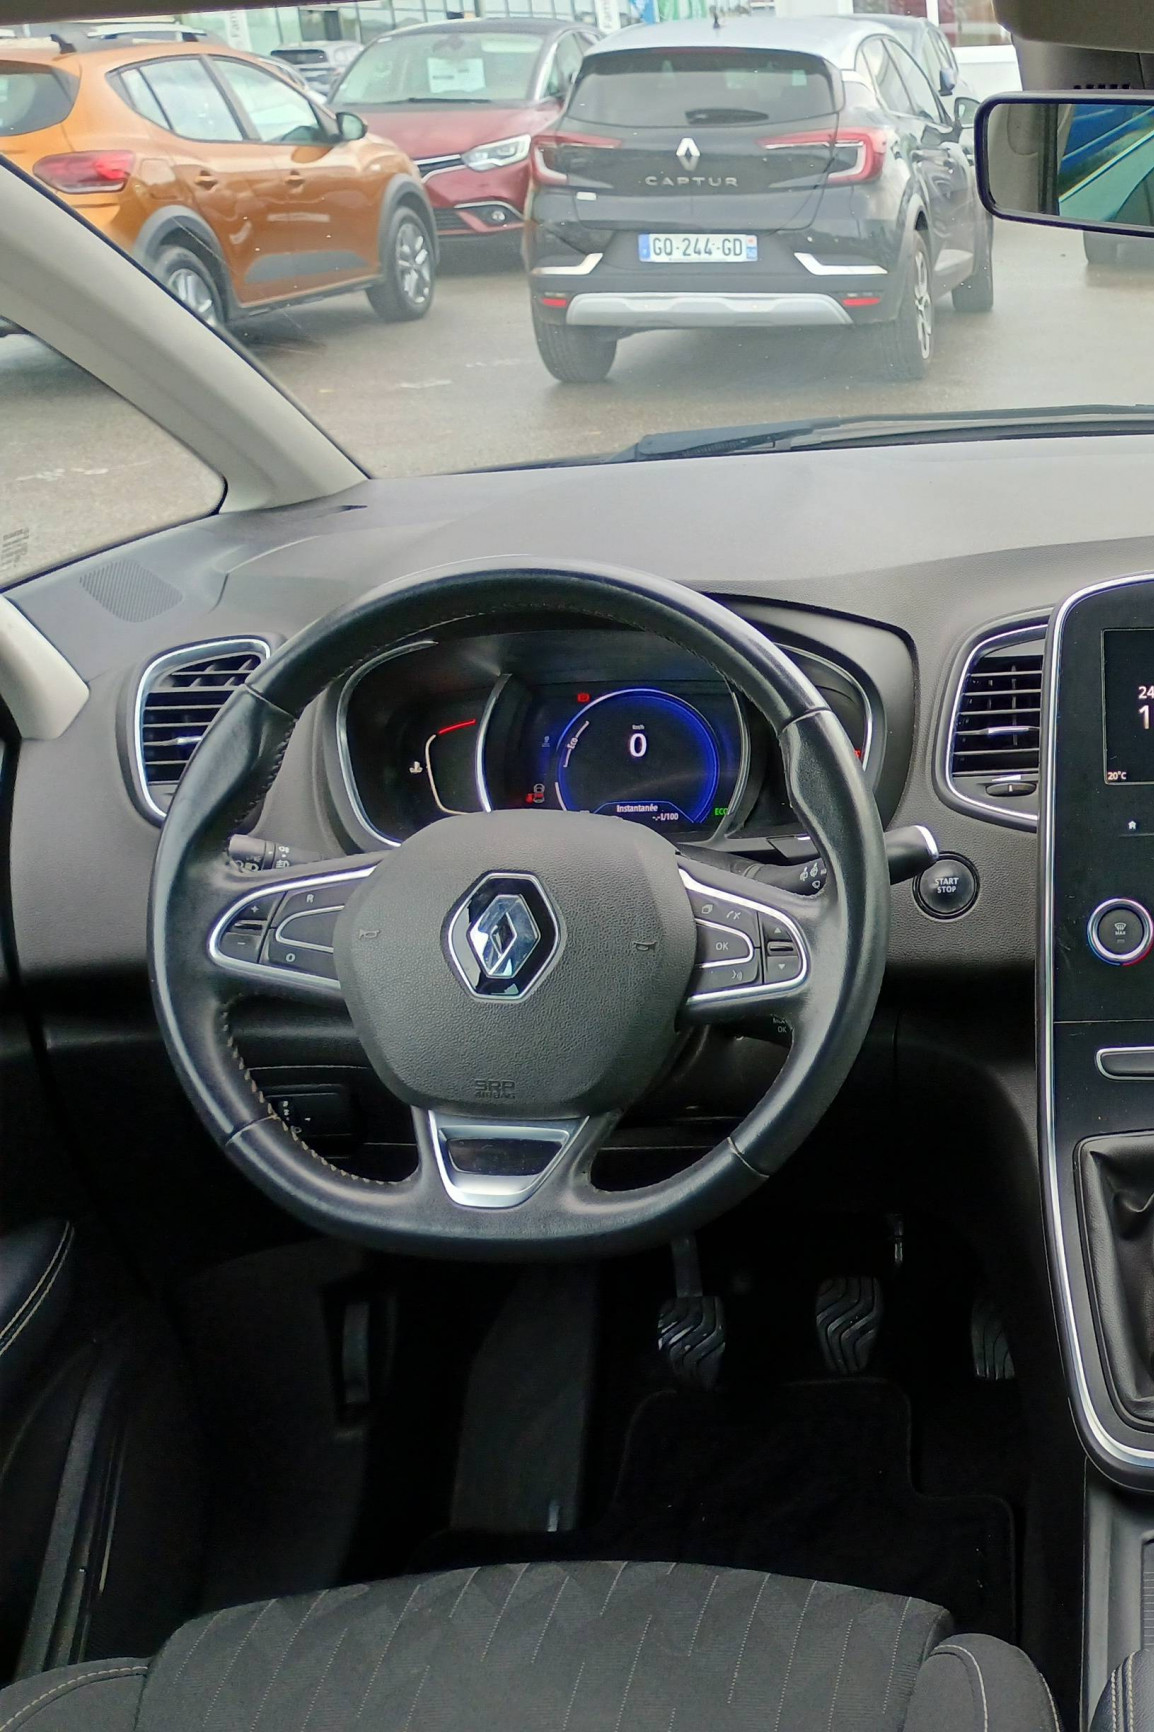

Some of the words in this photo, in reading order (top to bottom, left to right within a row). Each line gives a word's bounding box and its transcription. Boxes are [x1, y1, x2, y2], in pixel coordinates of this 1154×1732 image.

[645, 176, 738, 187] CAPTUR
[567, 737, 578, 750] Eco
[630, 733, 647, 757] 0
[1107, 771, 1127, 781] 20°C
[616, 803, 658, 813] Instantanée
[935, 877, 959, 886] START
[937, 886, 957, 894] STOP
[306, 893, 315, 903] R
[716, 942, 729, 950] OK
